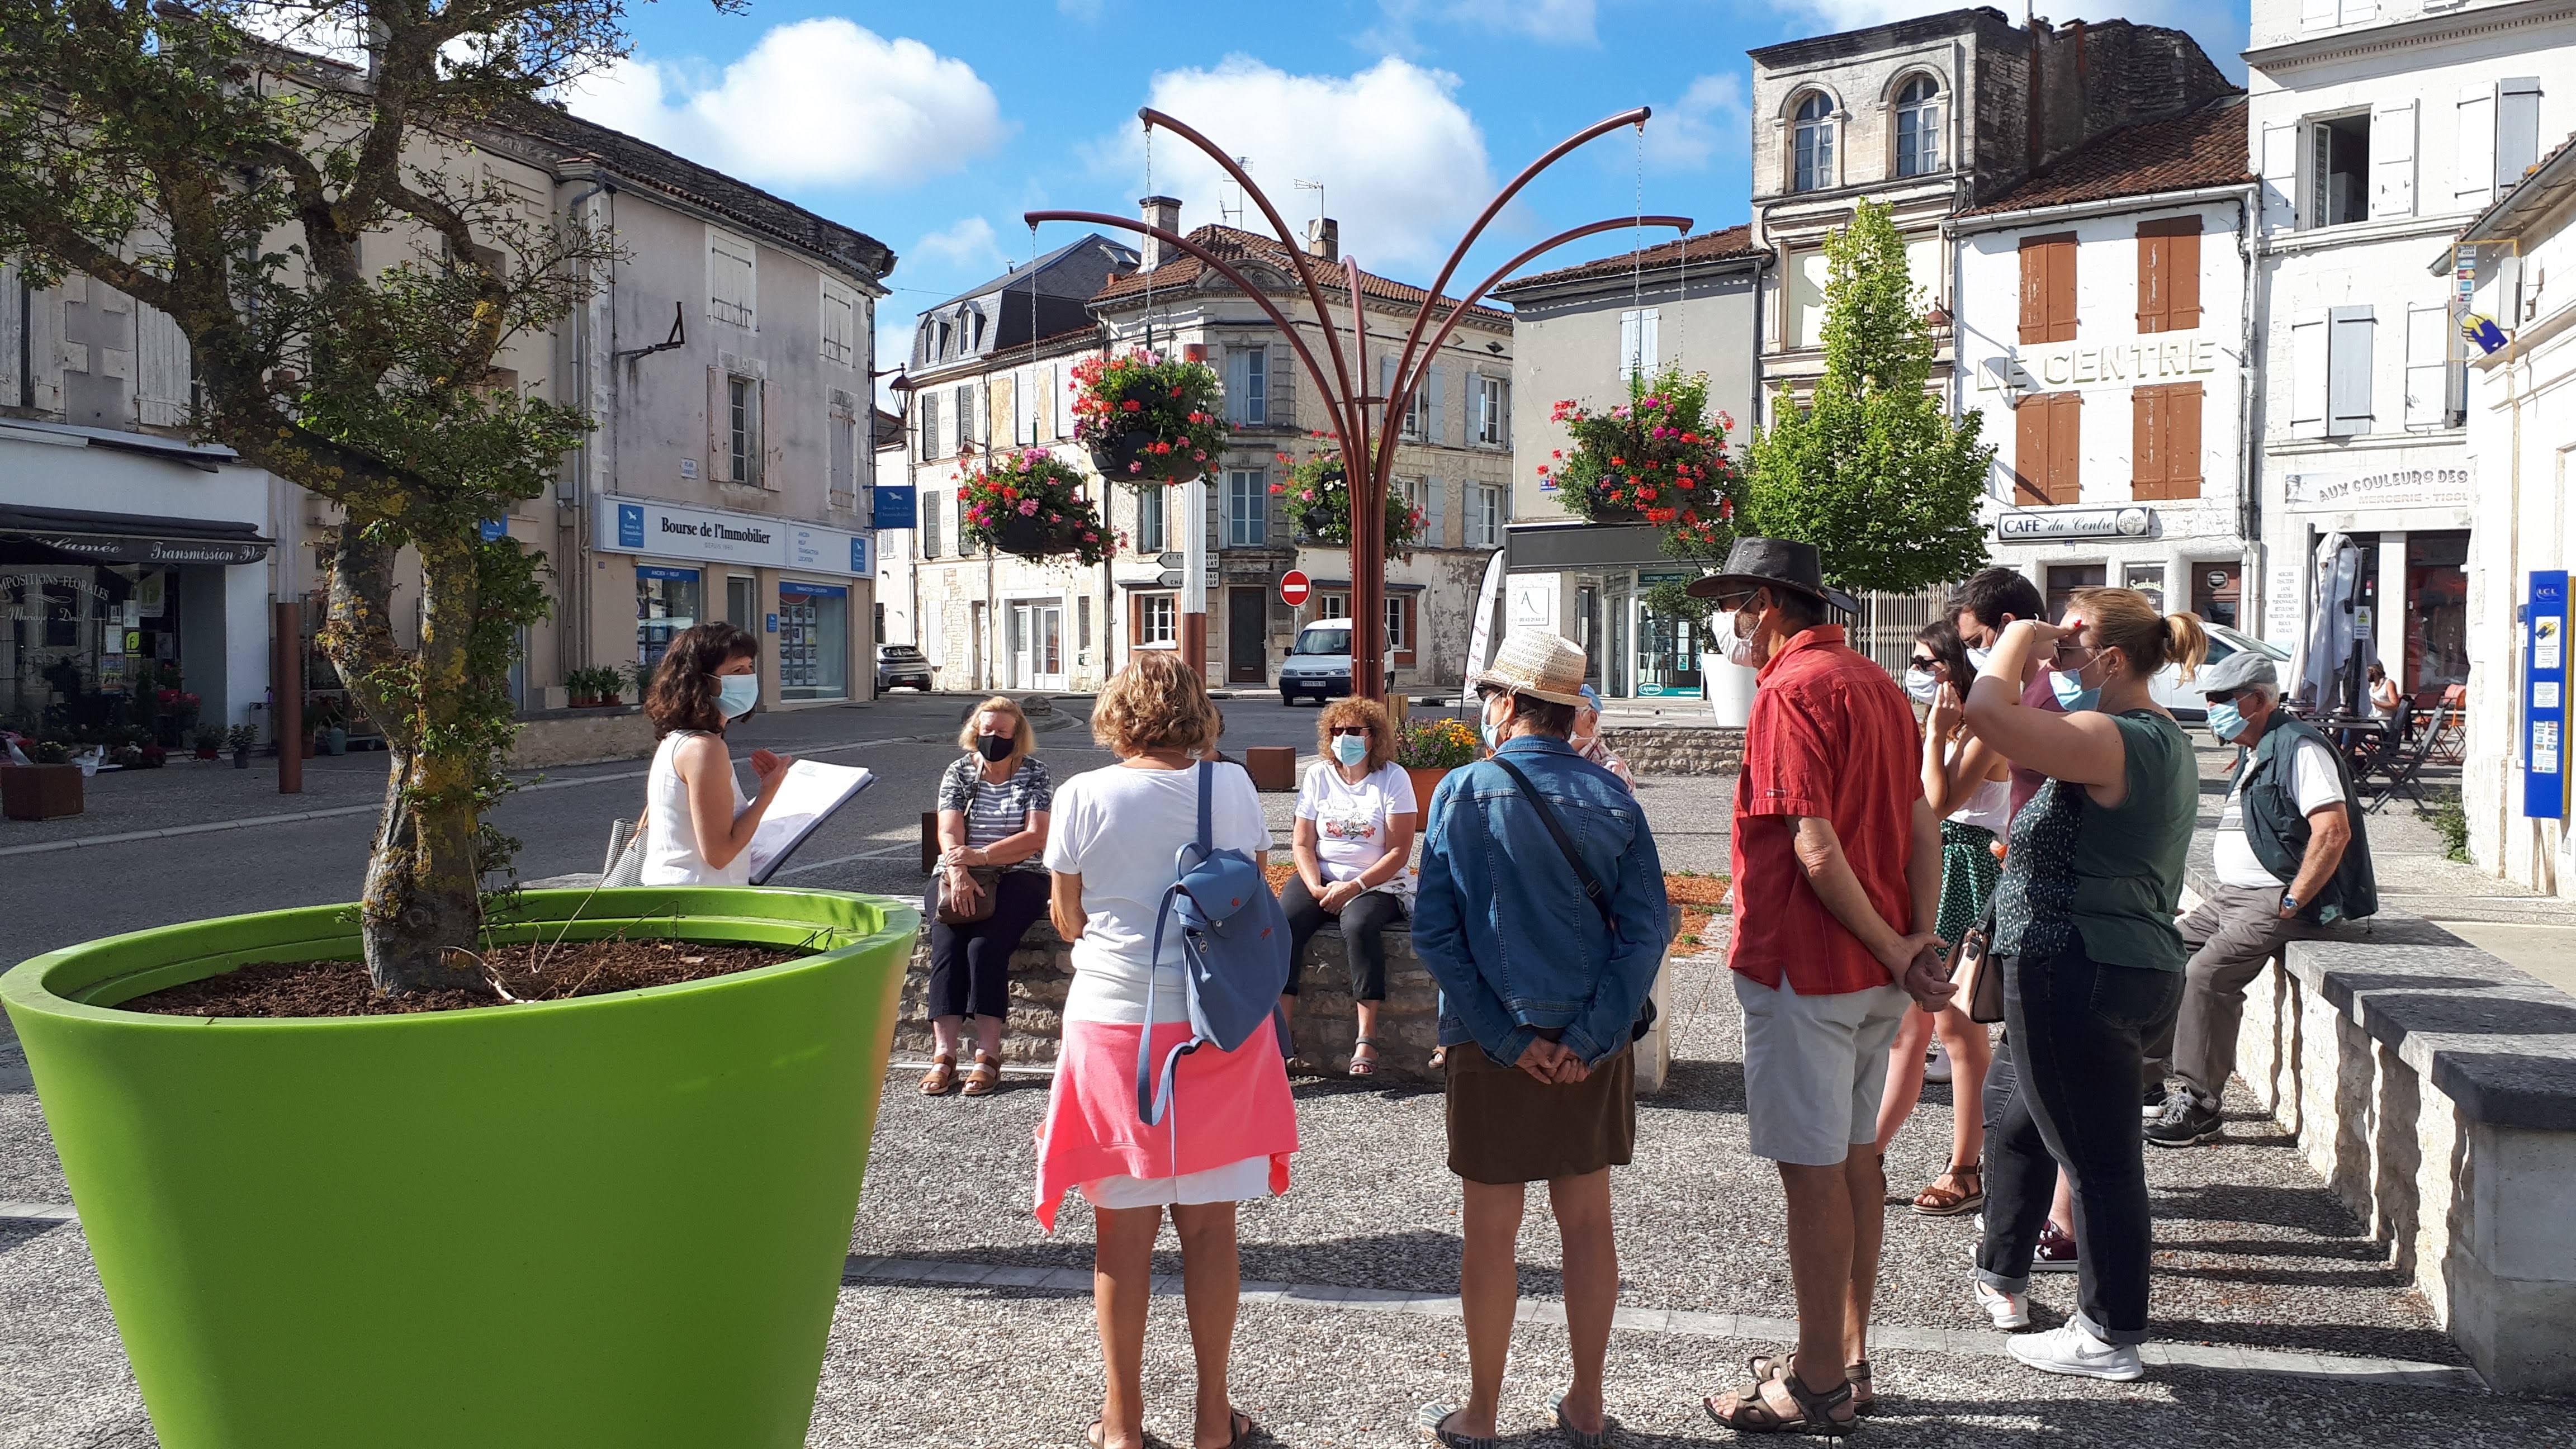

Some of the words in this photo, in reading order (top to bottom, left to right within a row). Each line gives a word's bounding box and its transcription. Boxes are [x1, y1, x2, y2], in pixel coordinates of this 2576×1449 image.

[1977, 357, 2028, 391] LE
[2044, 339, 2216, 385] CENTRE
[2319, 482, 2348, 503] AUX
[2352, 470, 2434, 493] COULEURS
[2437, 469, 2468, 484] DES
[2359, 493, 2422, 504] MERCERIE
[661, 517, 698, 535] Bourse
[700, 522, 712, 537] de
[714, 523, 771, 544] l'Immobilier
[2005, 520, 2040, 533] CAFE
[2048, 518, 2064, 531] du
[2072, 517, 2113, 531] Centre
[151, 541, 234, 561] Transmission
[63, 575, 110, 601] FLORALES
[9, 607, 48, 623] Mariage
[59, 608, 86, 622] Deuil
